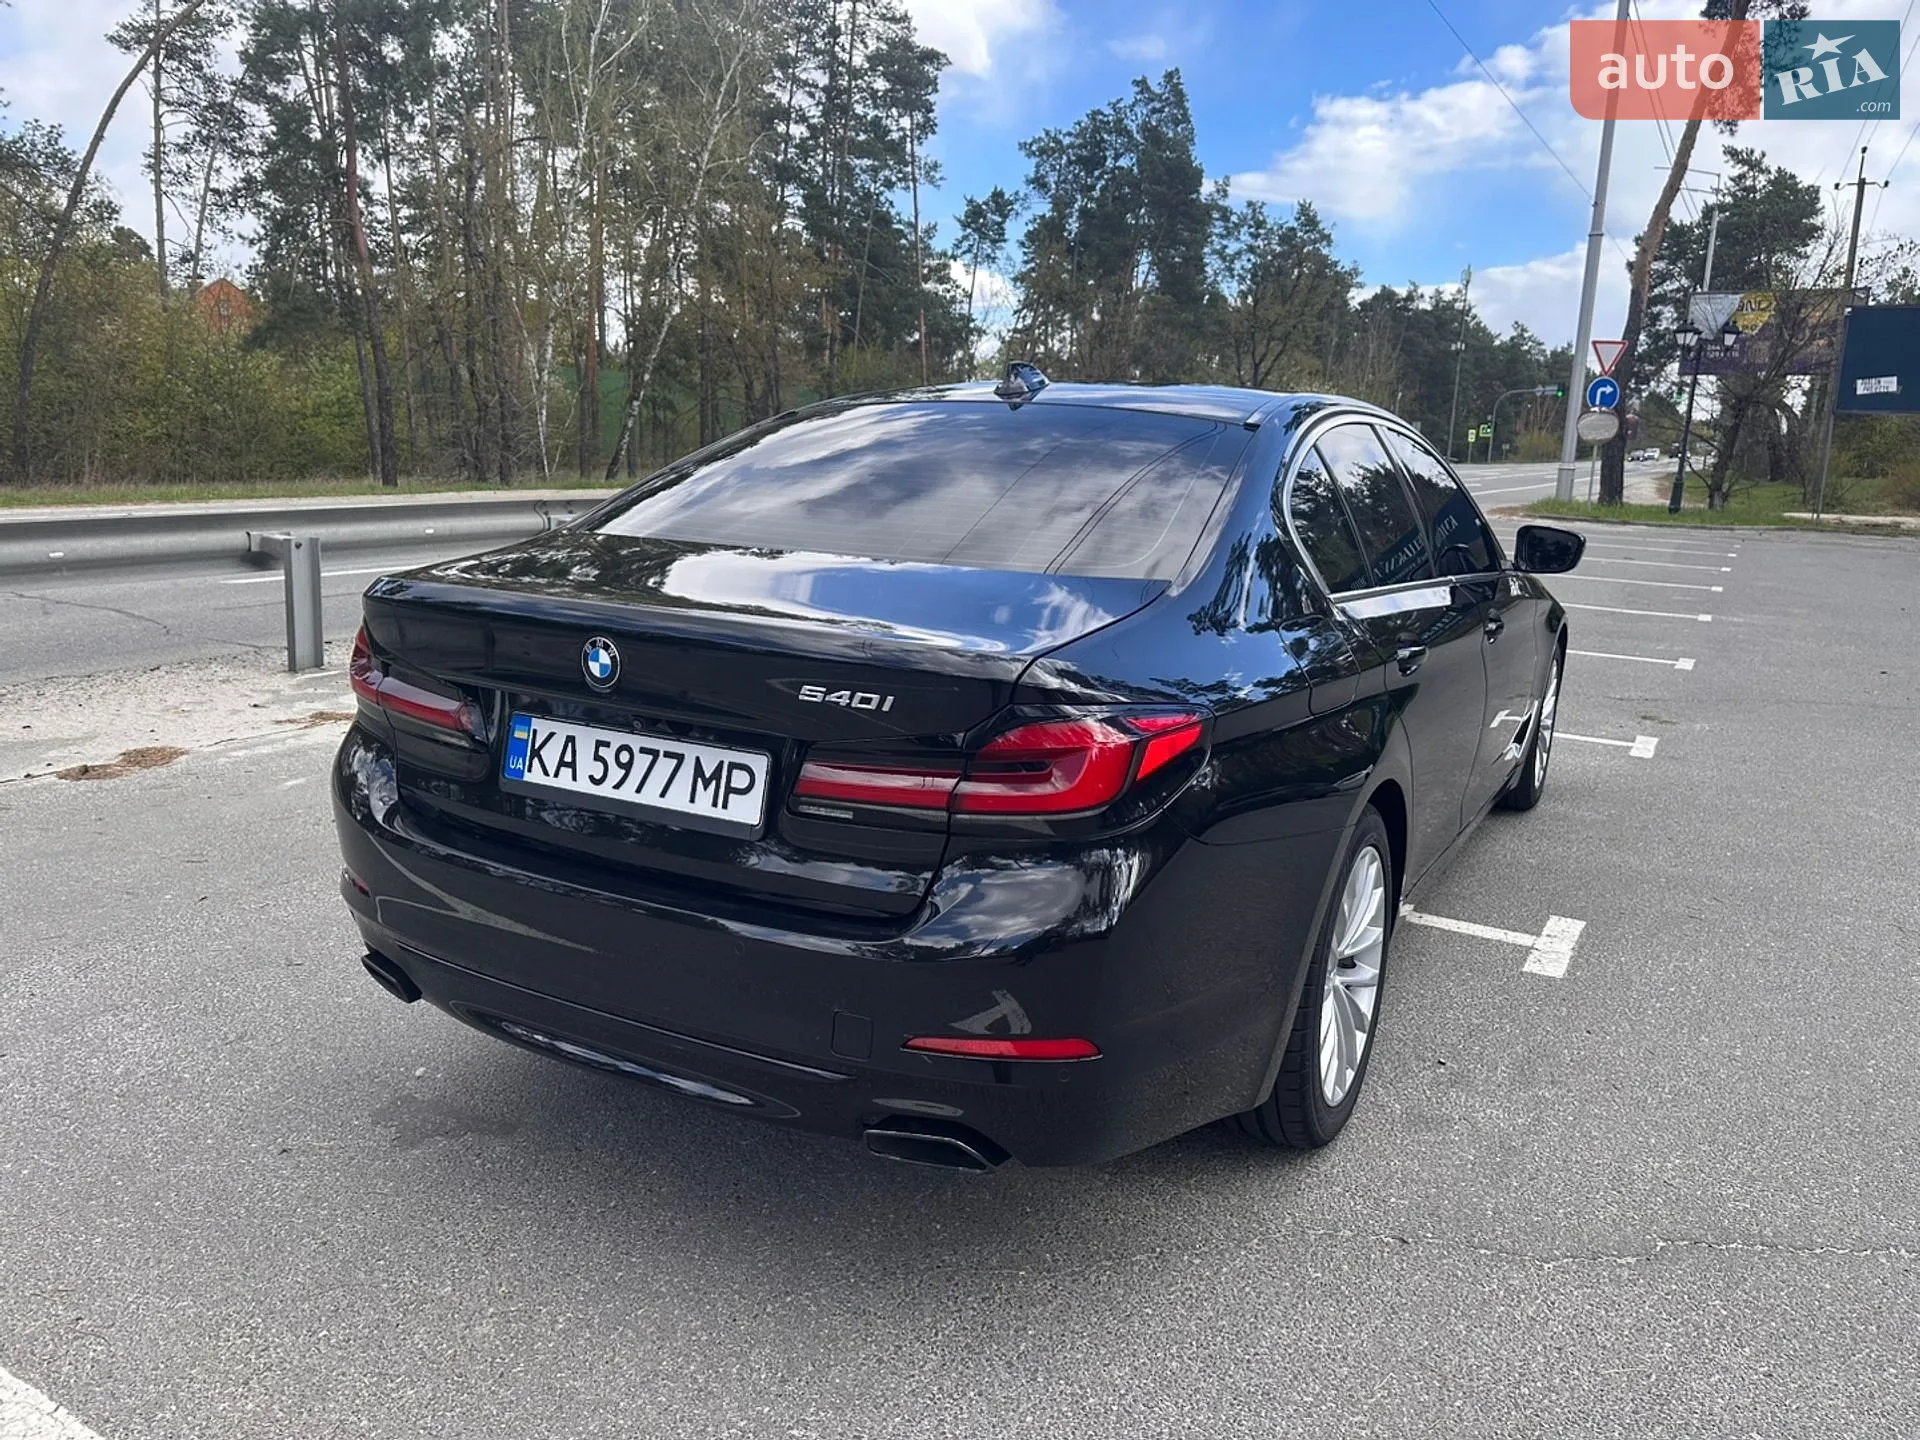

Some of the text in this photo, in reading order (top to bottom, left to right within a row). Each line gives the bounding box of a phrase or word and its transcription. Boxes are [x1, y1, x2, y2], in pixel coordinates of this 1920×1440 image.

[509, 755, 524, 770] UA
[526, 728, 756, 810] KA 5977 MP
